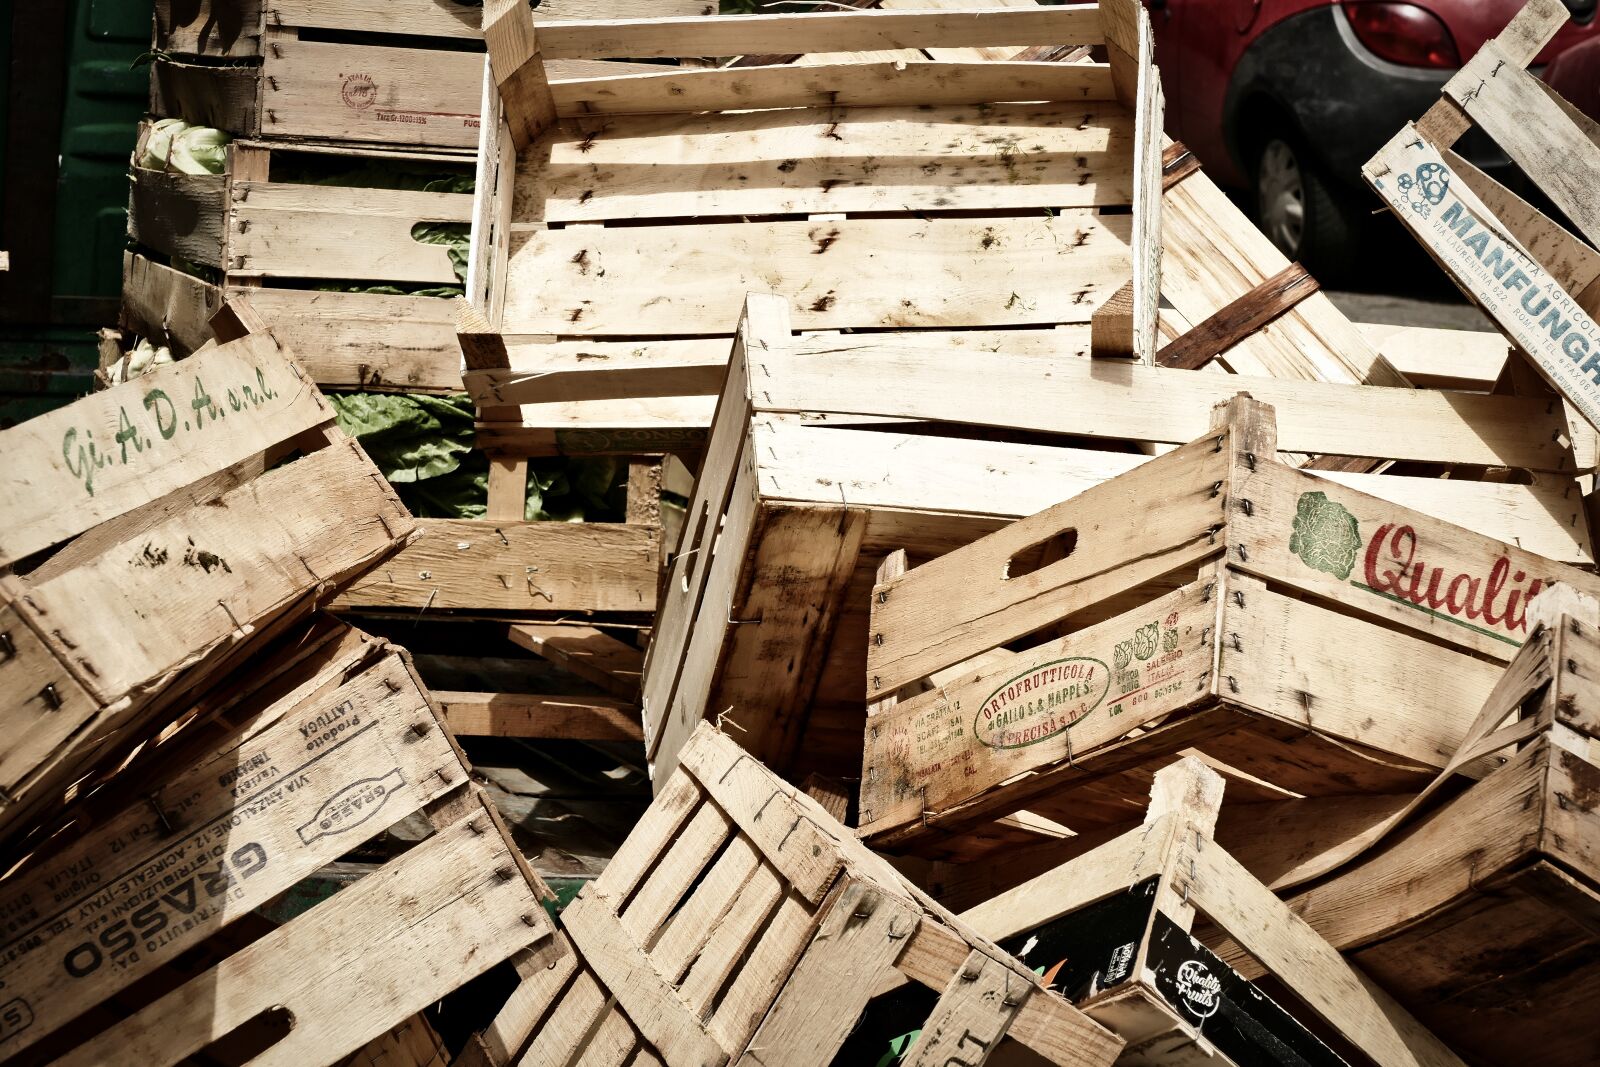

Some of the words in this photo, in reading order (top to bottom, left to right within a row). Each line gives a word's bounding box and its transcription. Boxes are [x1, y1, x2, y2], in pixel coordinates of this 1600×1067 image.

[1432, 221, 1447, 236] VIA
[1444, 236, 1494, 285] LAURENTINA
[1491, 285, 1508, 301] 622
[1512, 308, 1536, 331] ROMA
[1564, 363, 1580, 379] FAX
[1478, 292, 1500, 313] ORIG.
[1516, 332, 1539, 355] ITALIA
[984, 665, 1096, 721] ORTOFRUTTICOLA
[299, 700, 353, 738] LATTUGA
[305, 714, 360, 752] Prodotto
[996, 706, 1024, 728] GALLO
[1007, 722, 1057, 746] PRECISA
[285, 774, 309, 793] VIA
[318, 784, 386, 830] GRASSO
[108, 836, 127, 852] 12
[44, 856, 92, 891] ITALIA
[52, 869, 100, 903] Origine
[62, 841, 269, 980] GRASSO
[1175, 981, 1213, 1008] Fruits
[1184, 962, 1221, 993] Quality
